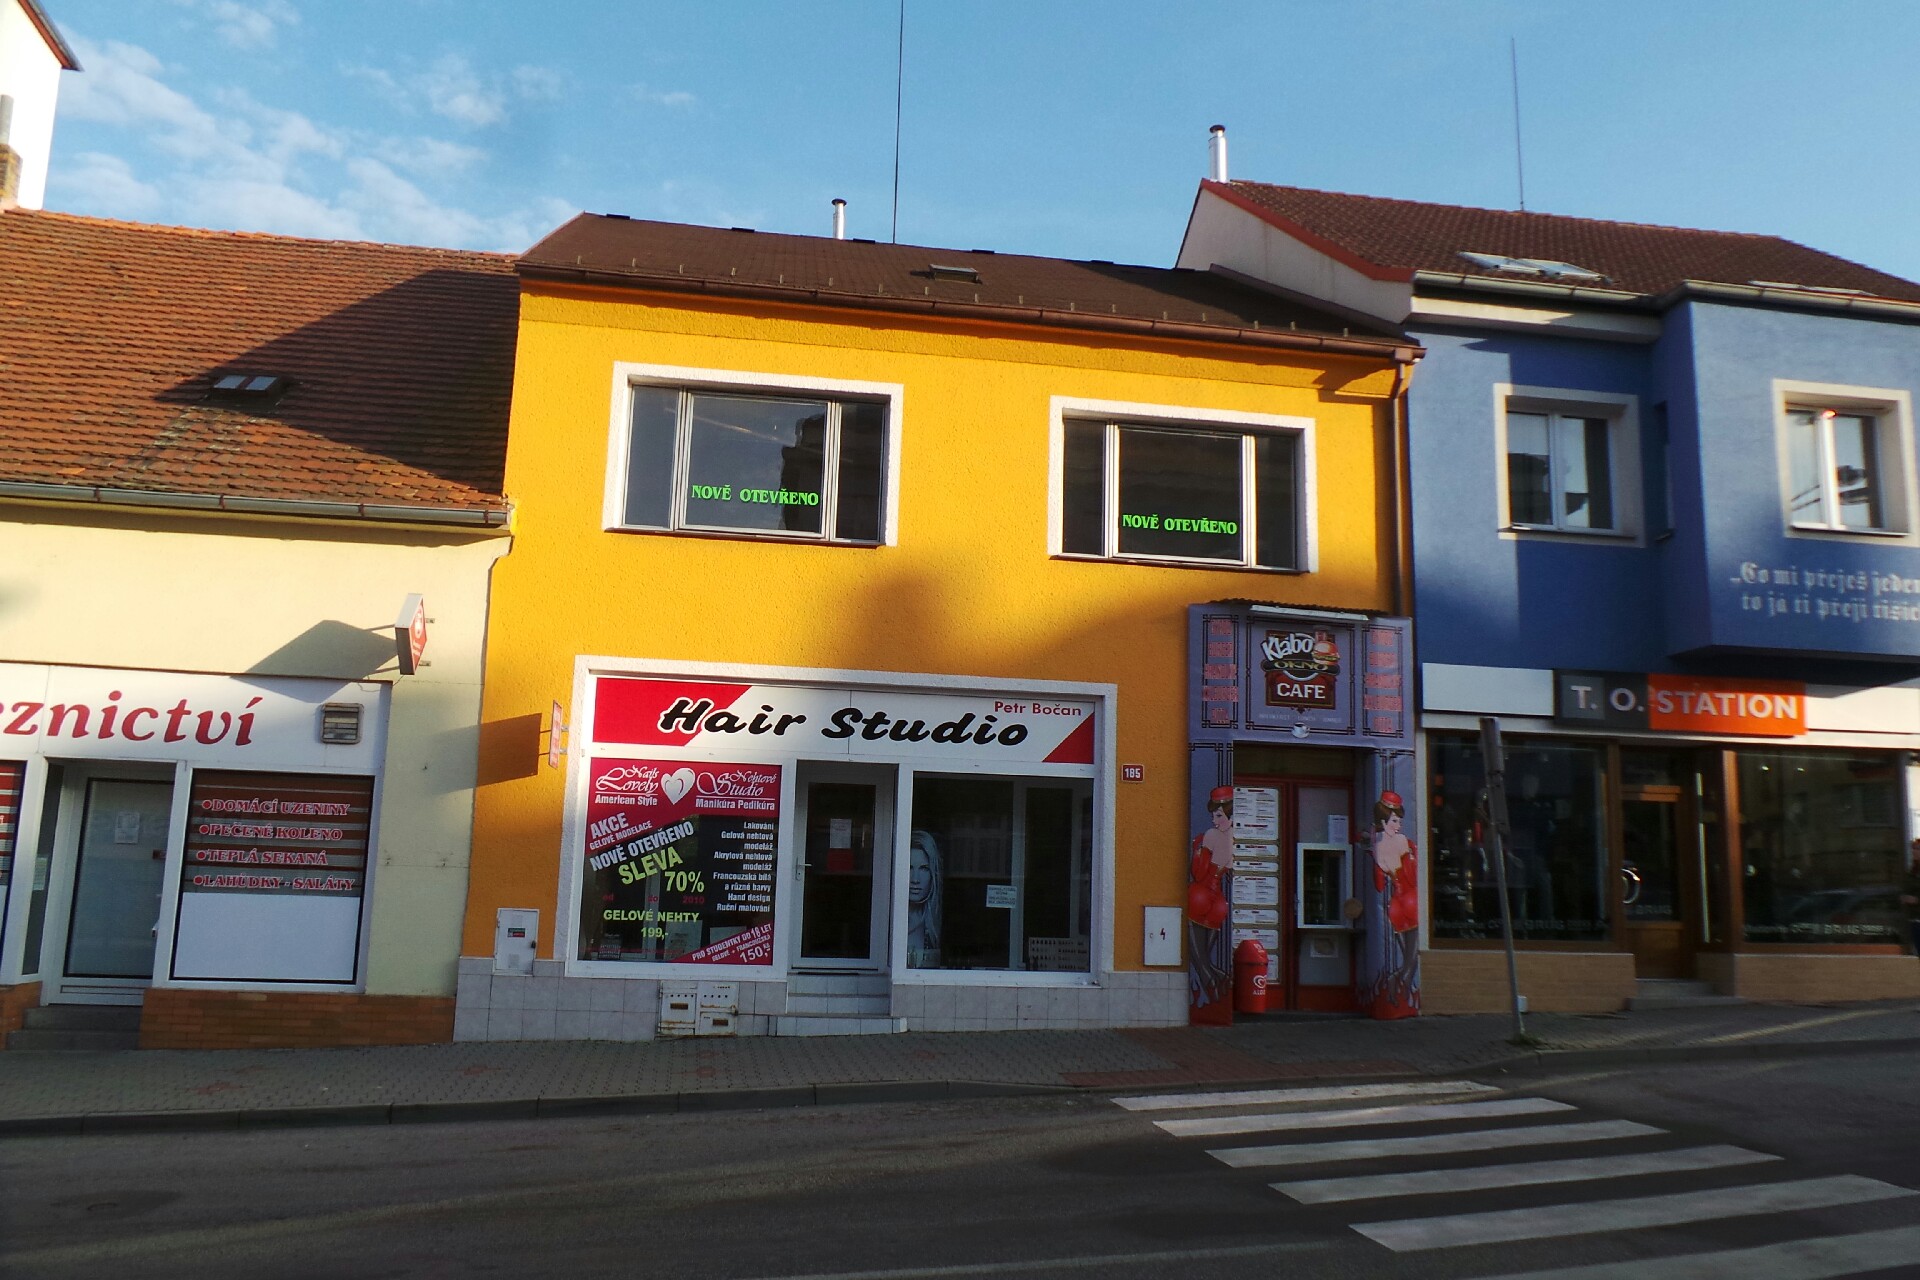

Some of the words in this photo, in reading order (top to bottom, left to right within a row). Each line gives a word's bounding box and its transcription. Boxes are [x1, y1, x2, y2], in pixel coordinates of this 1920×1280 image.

[691, 484, 732, 501] NOVĚ
[739, 488, 819, 506] OTEVŘENO
[1122, 514, 1159, 530] NOVĚ
[1164, 517, 1238, 535] OTEVŘENO
[1274, 660, 1328, 671] OKNO
[1277, 682, 1326, 699] CAFE
[993, 699, 1029, 716] Petr
[1033, 701, 1083, 717] Bočan
[1656, 689, 1799, 720] STATION
[0, 689, 264, 747] znictví
[657, 696, 807, 738] Hair
[820, 706, 1030, 747] Studio
[625, 765, 660, 779] Nails
[1124, 767, 1141, 779] 185
[696, 772, 764, 797] Studio
[212, 798, 278, 814] DOMÁCÍ
[280, 802, 351, 816] UZENINY
[595, 795, 635, 805] American
[637, 795, 658, 806] Style
[695, 798, 736, 809] Manikúra
[738, 799, 775, 810] Pedikúra
[209, 822, 273, 839] PEČENÉ
[275, 826, 343, 841] KOLENO
[590, 812, 629, 839] AKCE
[721, 831, 745, 839] Gelová
[589, 844, 628, 872] NOVĚ
[627, 821, 695, 857] OTEVŘENO
[207, 848, 259, 864] TEPLÁ
[261, 850, 328, 865] SEKANÁ
[618, 846, 684, 885] SLEVA
[292, 876, 355, 891] SALÁTY
[664, 871, 705, 893] 70%
[728, 892, 746, 901] Hand
[747, 893, 771, 902] design
[603, 908, 654, 921] GELOVÉ
[657, 911, 700, 923] NEHTY
